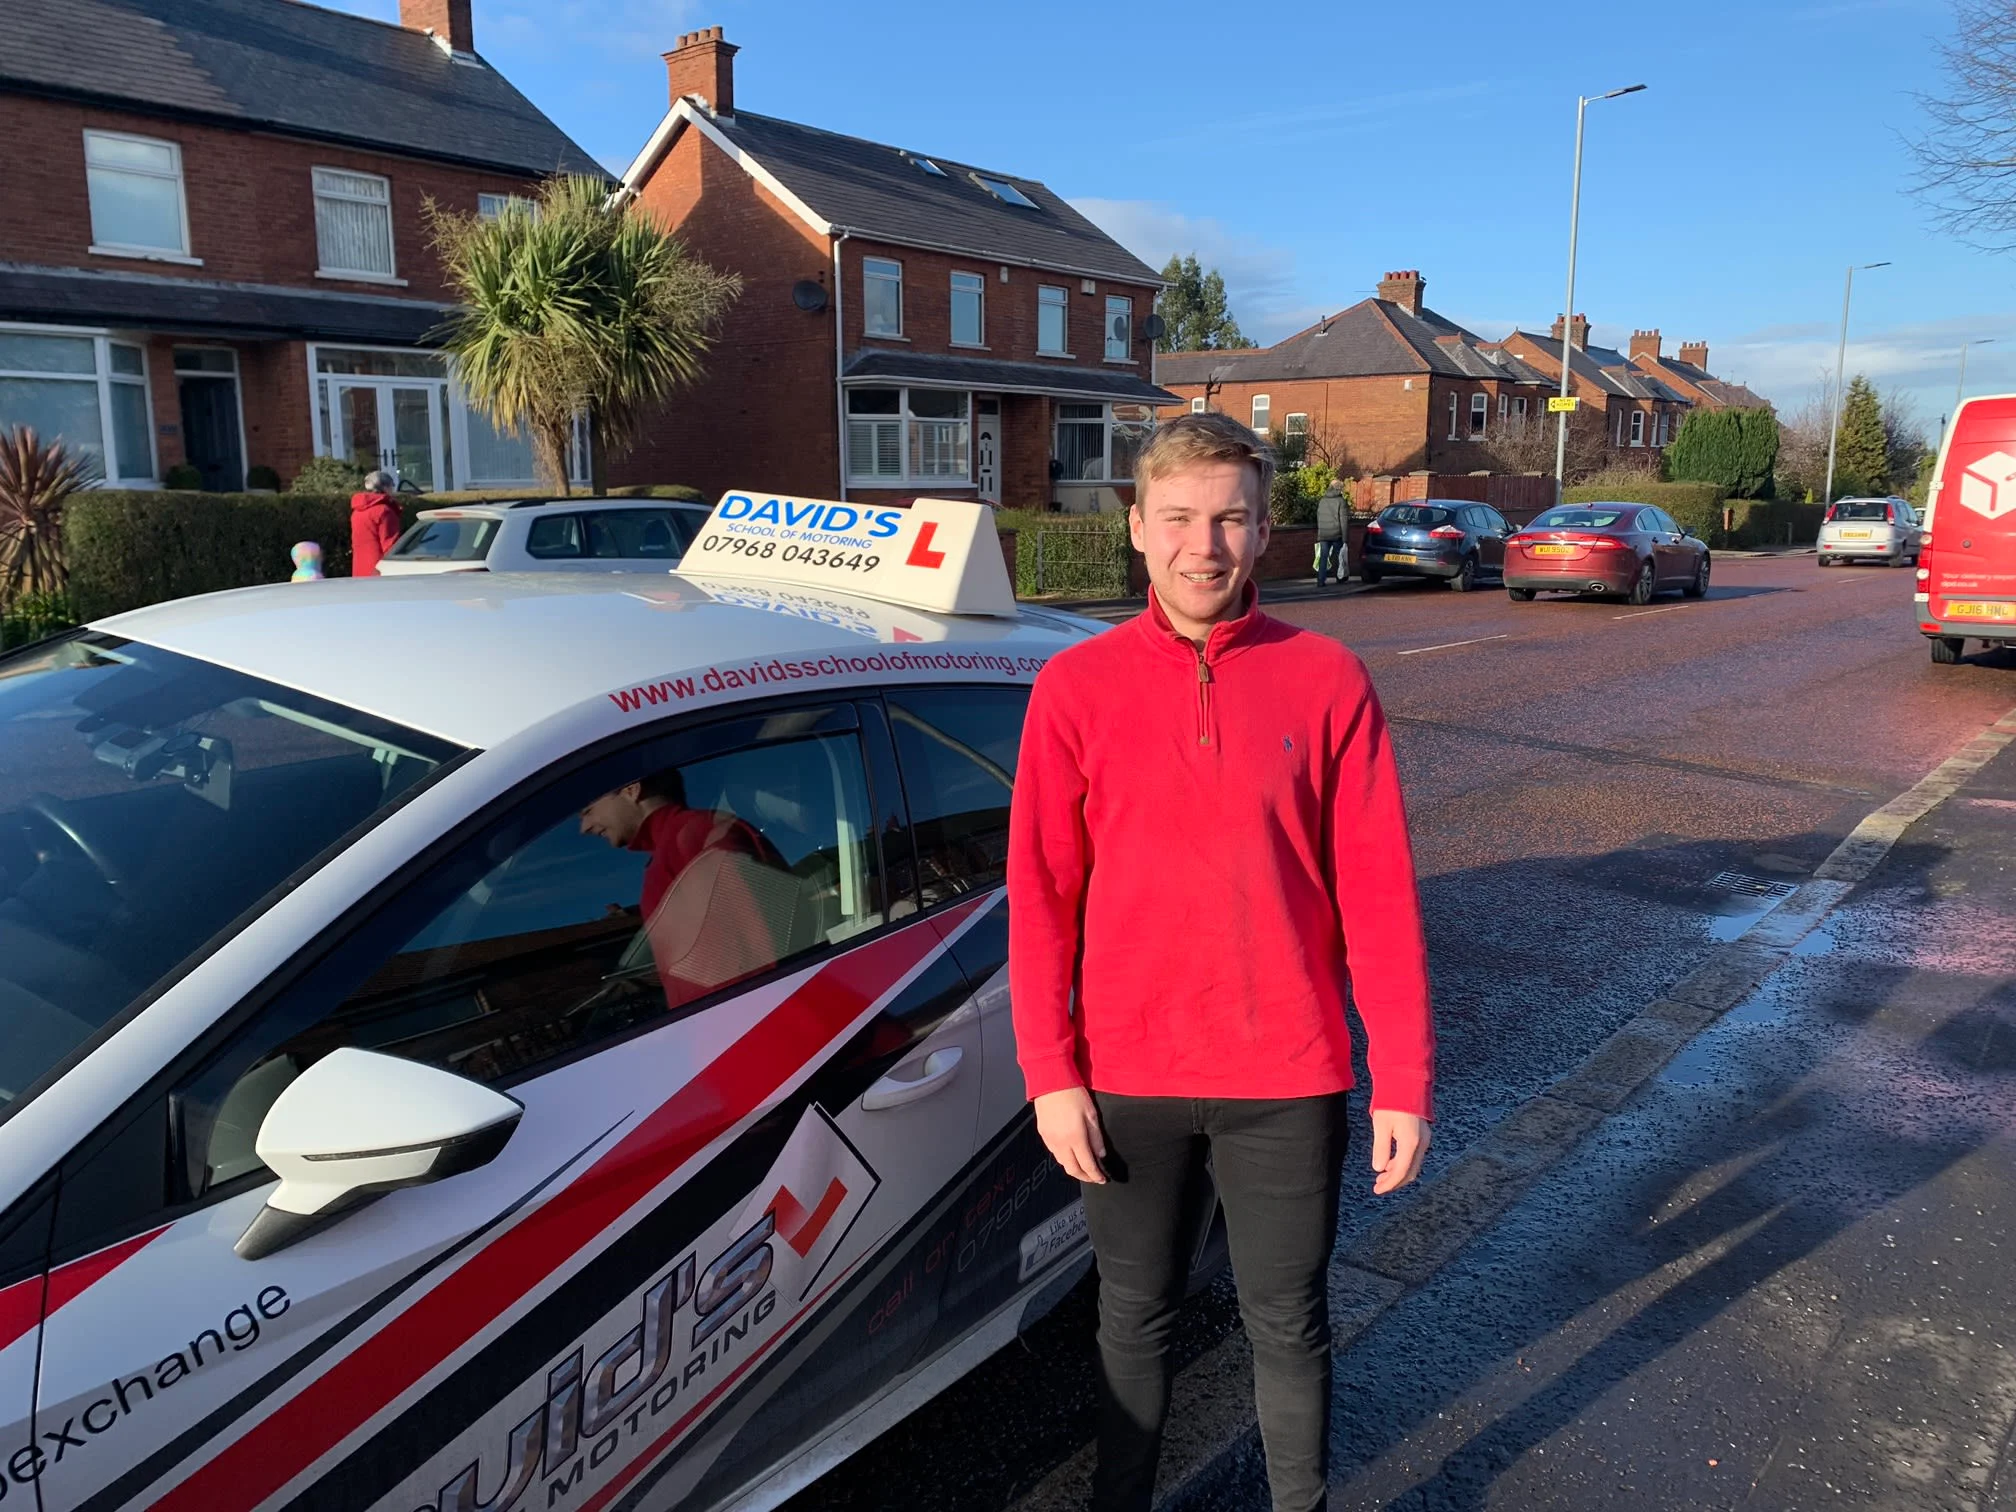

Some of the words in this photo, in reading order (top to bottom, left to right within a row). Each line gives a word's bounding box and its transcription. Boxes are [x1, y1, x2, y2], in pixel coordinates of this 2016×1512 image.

[718, 495, 902, 538] DAVID'S
[726, 522, 776, 538] SCHOOL
[780, 529, 797, 540] OF
[800, 531, 873, 550] MOTORING
[702, 535, 776, 559] 07968
[782, 544, 880, 574] 043649
[905, 521, 946, 569] L
[1049, 1219, 1087, 1253] Facebo
[868, 1270, 914, 1337] call
[0, 1284, 291, 1502] exchange
[547, 1288, 777, 1507] MOTORING
